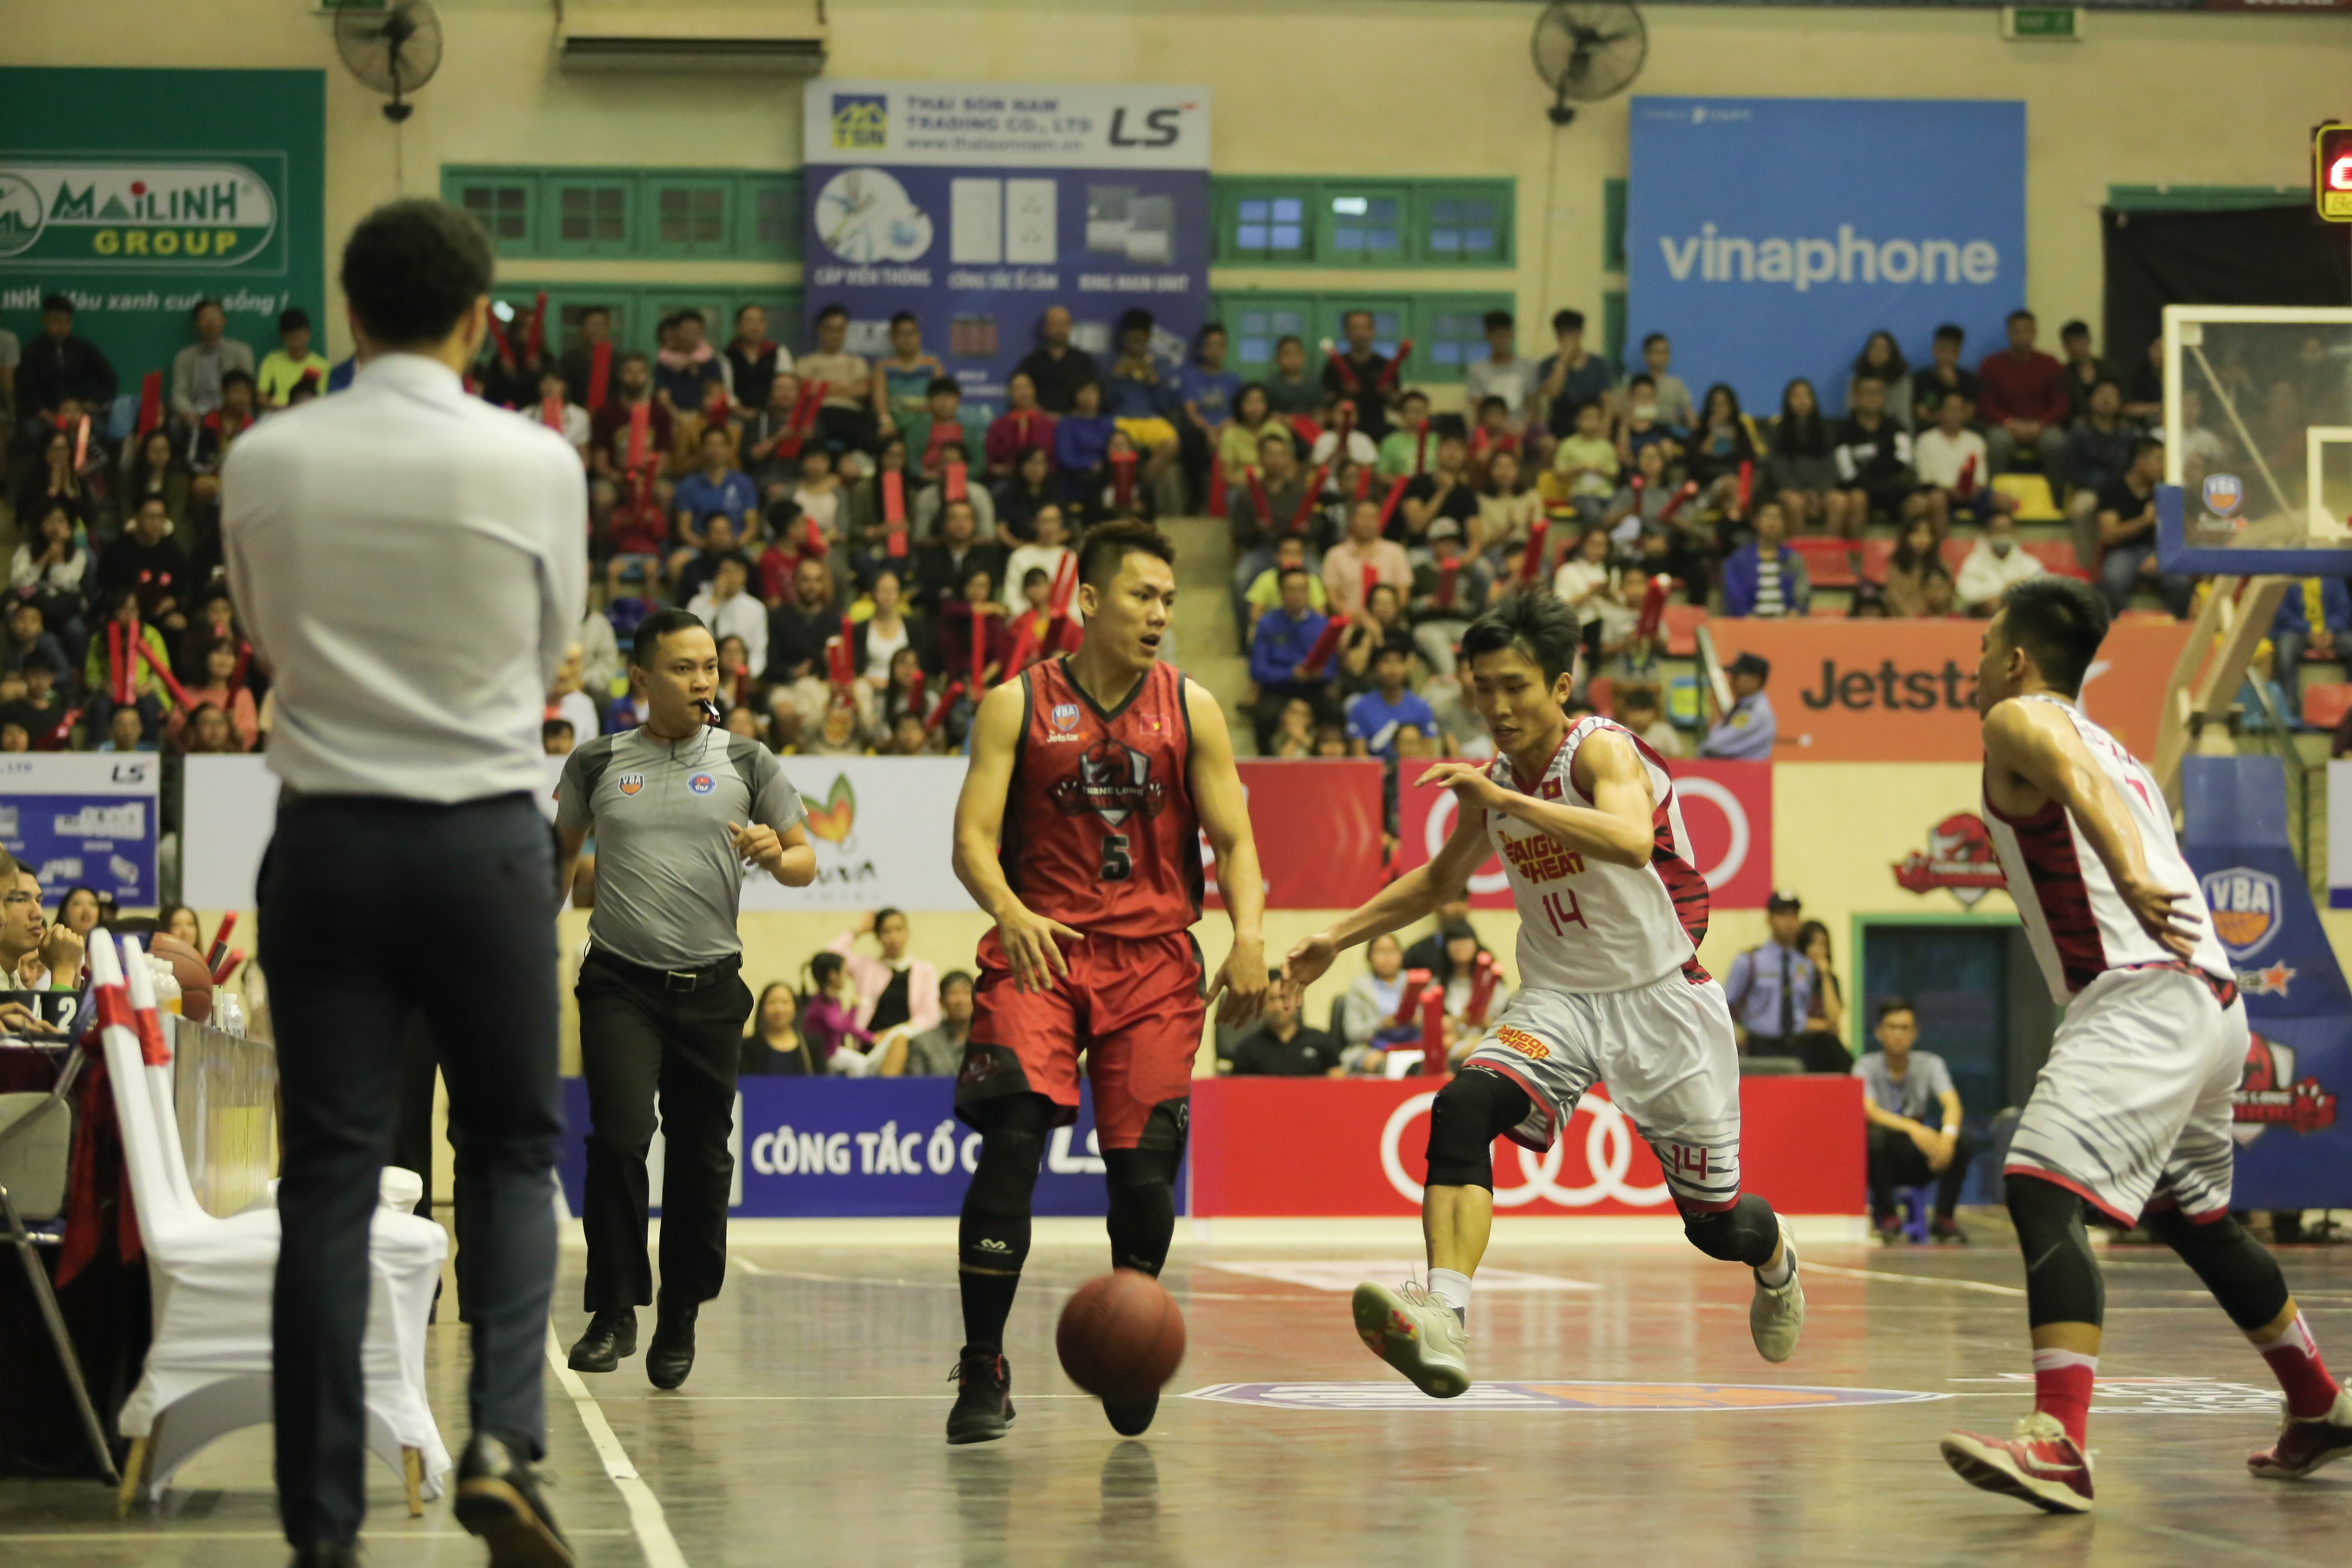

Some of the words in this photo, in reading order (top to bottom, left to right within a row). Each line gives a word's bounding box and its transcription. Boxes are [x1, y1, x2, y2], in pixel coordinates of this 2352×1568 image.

[906, 116, 998, 132] TRADING
[1107, 107, 1180, 147] LS
[94, 230, 238, 255] GROUP
[1660, 221, 1998, 292] vinaphone
[1, 285, 40, 309] INH
[1055, 706, 1075, 717] VBA
[112, 762, 146, 784] LS
[622, 775, 641, 784] VBA
[1100, 835, 1132, 881] 5
[1498, 830, 1571, 865] SAIGO
[1522, 851, 1585, 885] HEAT
[1542, 888, 1589, 936] 14
[2210, 877, 2270, 912] VBA
[57, 996, 77, 1034] 2
[751, 1125, 851, 1175] CÔNG
[856, 1120, 922, 1175] TẮC
[927, 1119, 956, 1175] Ổ
[1672, 1144, 1708, 1180] 14
